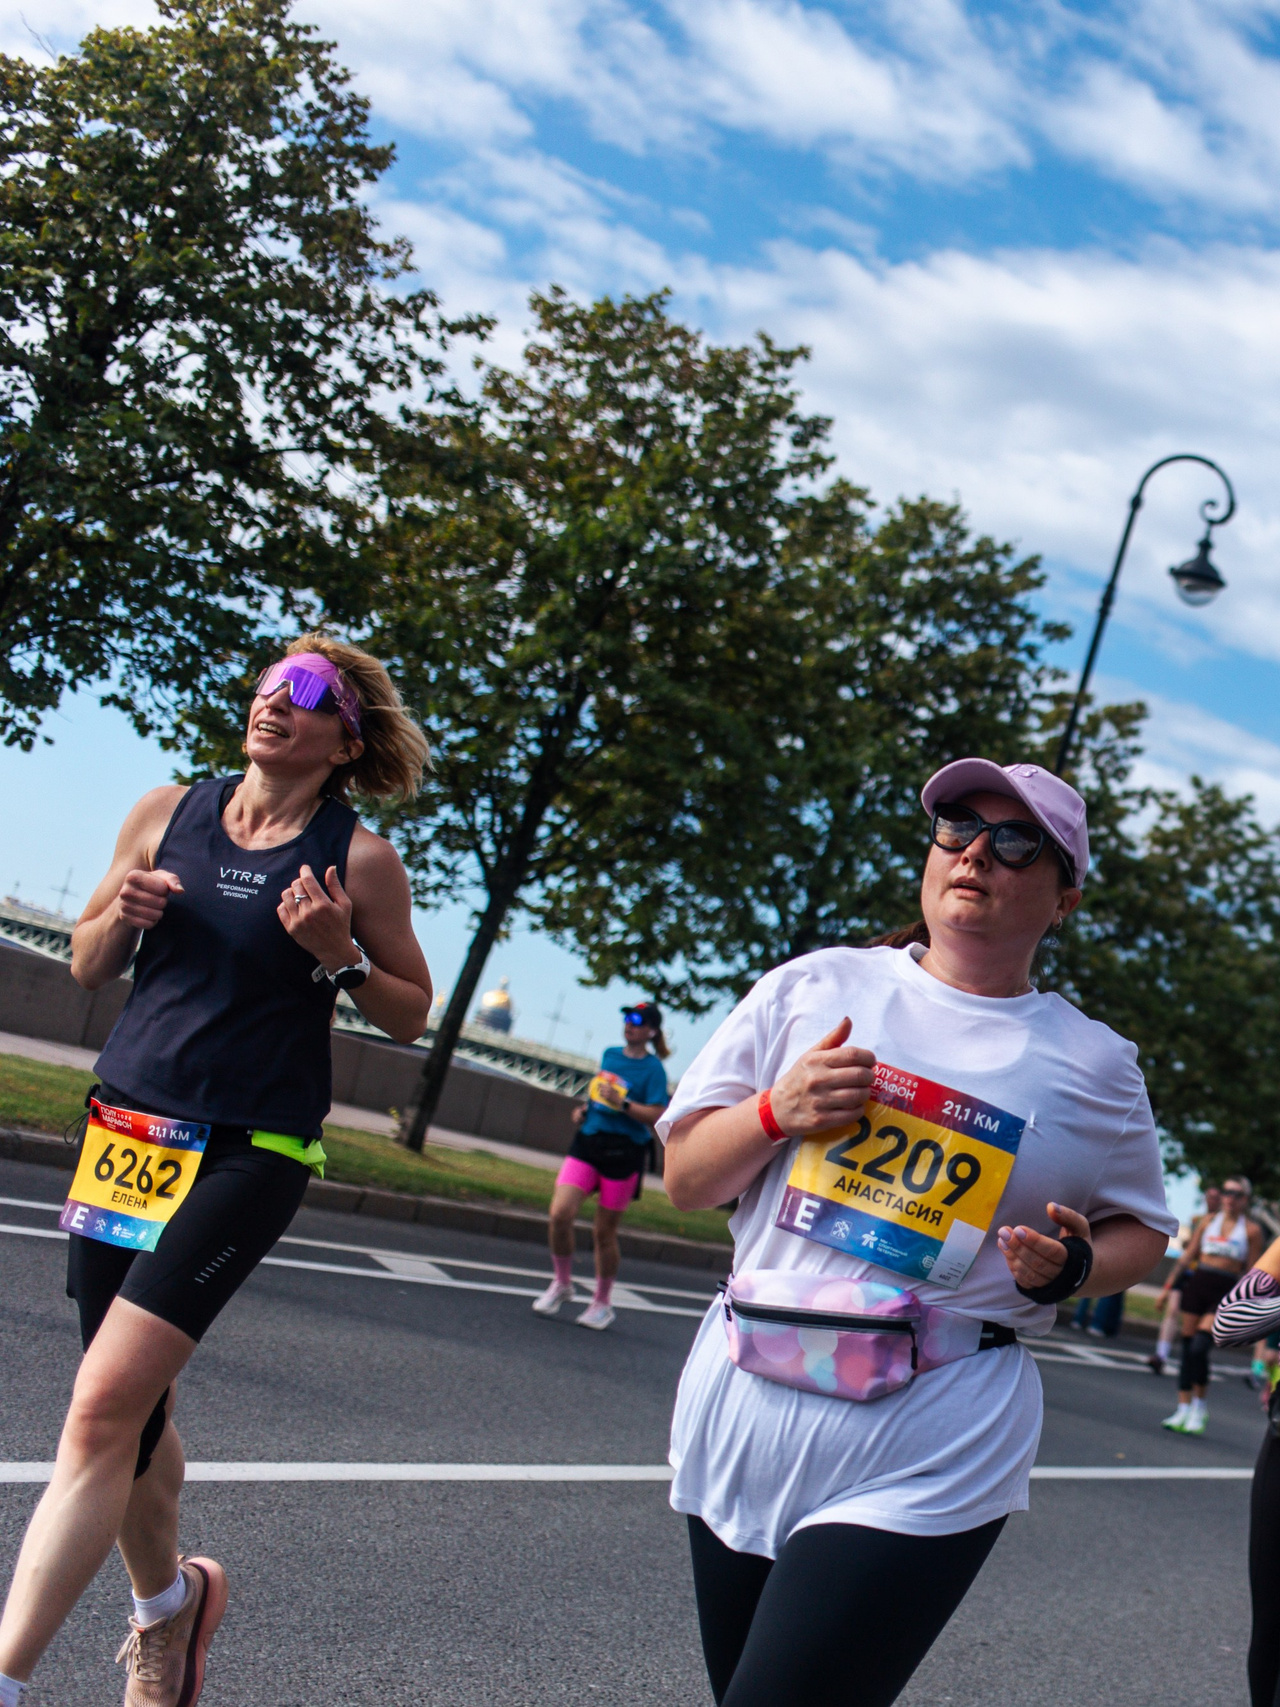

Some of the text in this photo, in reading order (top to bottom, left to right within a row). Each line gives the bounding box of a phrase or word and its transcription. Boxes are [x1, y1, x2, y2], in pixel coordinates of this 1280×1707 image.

[220, 867, 252, 882] VTR
[216, 883, 259, 894] PERFORMANCE
[223, 890, 249, 899] DIVISION
[871, 1078, 916, 1101] РАФОН
[893, 1074, 919, 1089] 2026
[100, 1106, 117, 1117] ПОЛУ
[941, 1100, 972, 1122] 21,1
[101, 1114, 132, 1130] МАРАФОН
[147, 1125, 167, 1138] 21,1
[825, 1115, 982, 1207] 2209
[94, 1143, 183, 1200] 6262
[111, 1190, 148, 1211] ЕЛЕНА
[833, 1174, 945, 1227] АНАСТАСИЯ
